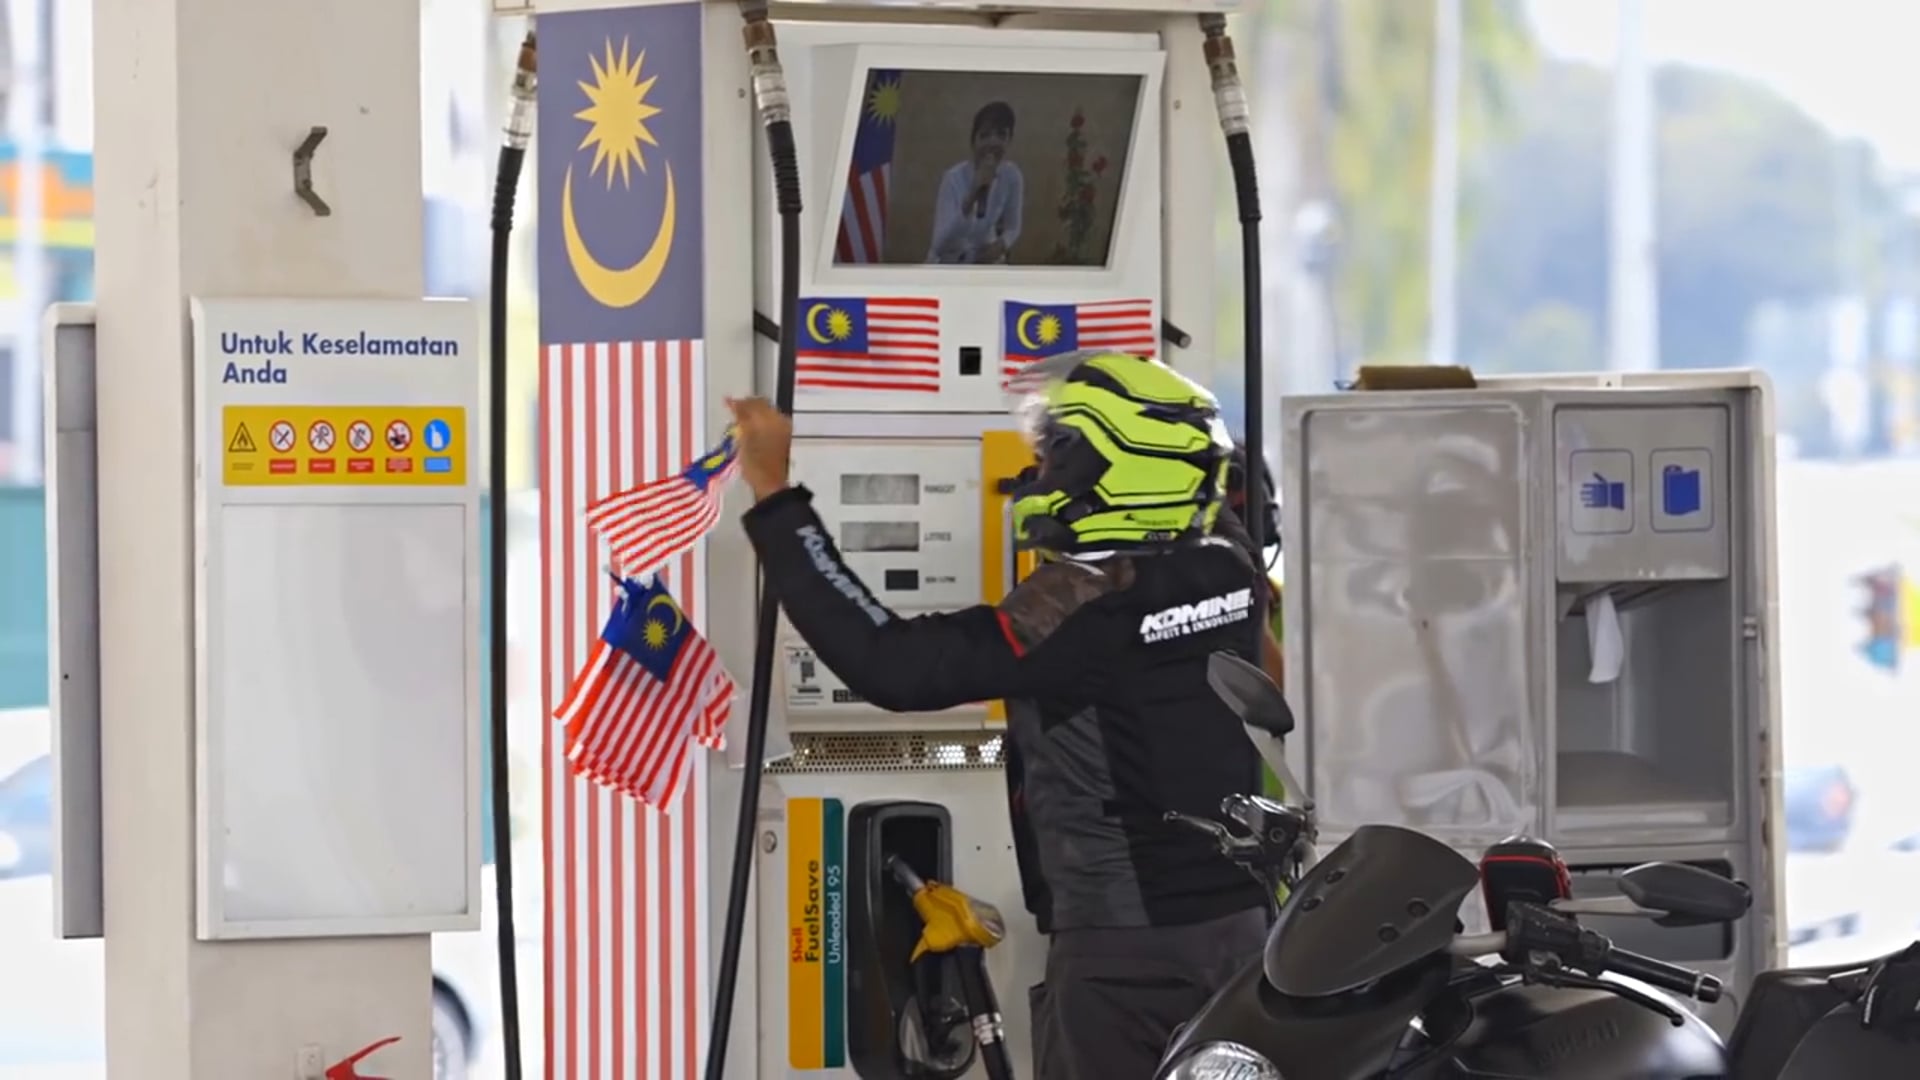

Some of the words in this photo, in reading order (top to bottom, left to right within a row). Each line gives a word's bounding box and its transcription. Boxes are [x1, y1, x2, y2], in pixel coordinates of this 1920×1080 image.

[221, 331, 293, 355] Untuk
[302, 331, 458, 356] Keselamatan
[222, 360, 288, 384] Anda
[1139, 588, 1251, 634] KOMINE
[1144, 626, 1180, 644] SAFETY
[1192, 609, 1249, 633] INNOVATION
[827, 865, 841, 887] 95
[803, 860, 820, 962] FuelSave
[828, 891, 842, 964] Unleaded
[792, 927, 804, 963] Shell
